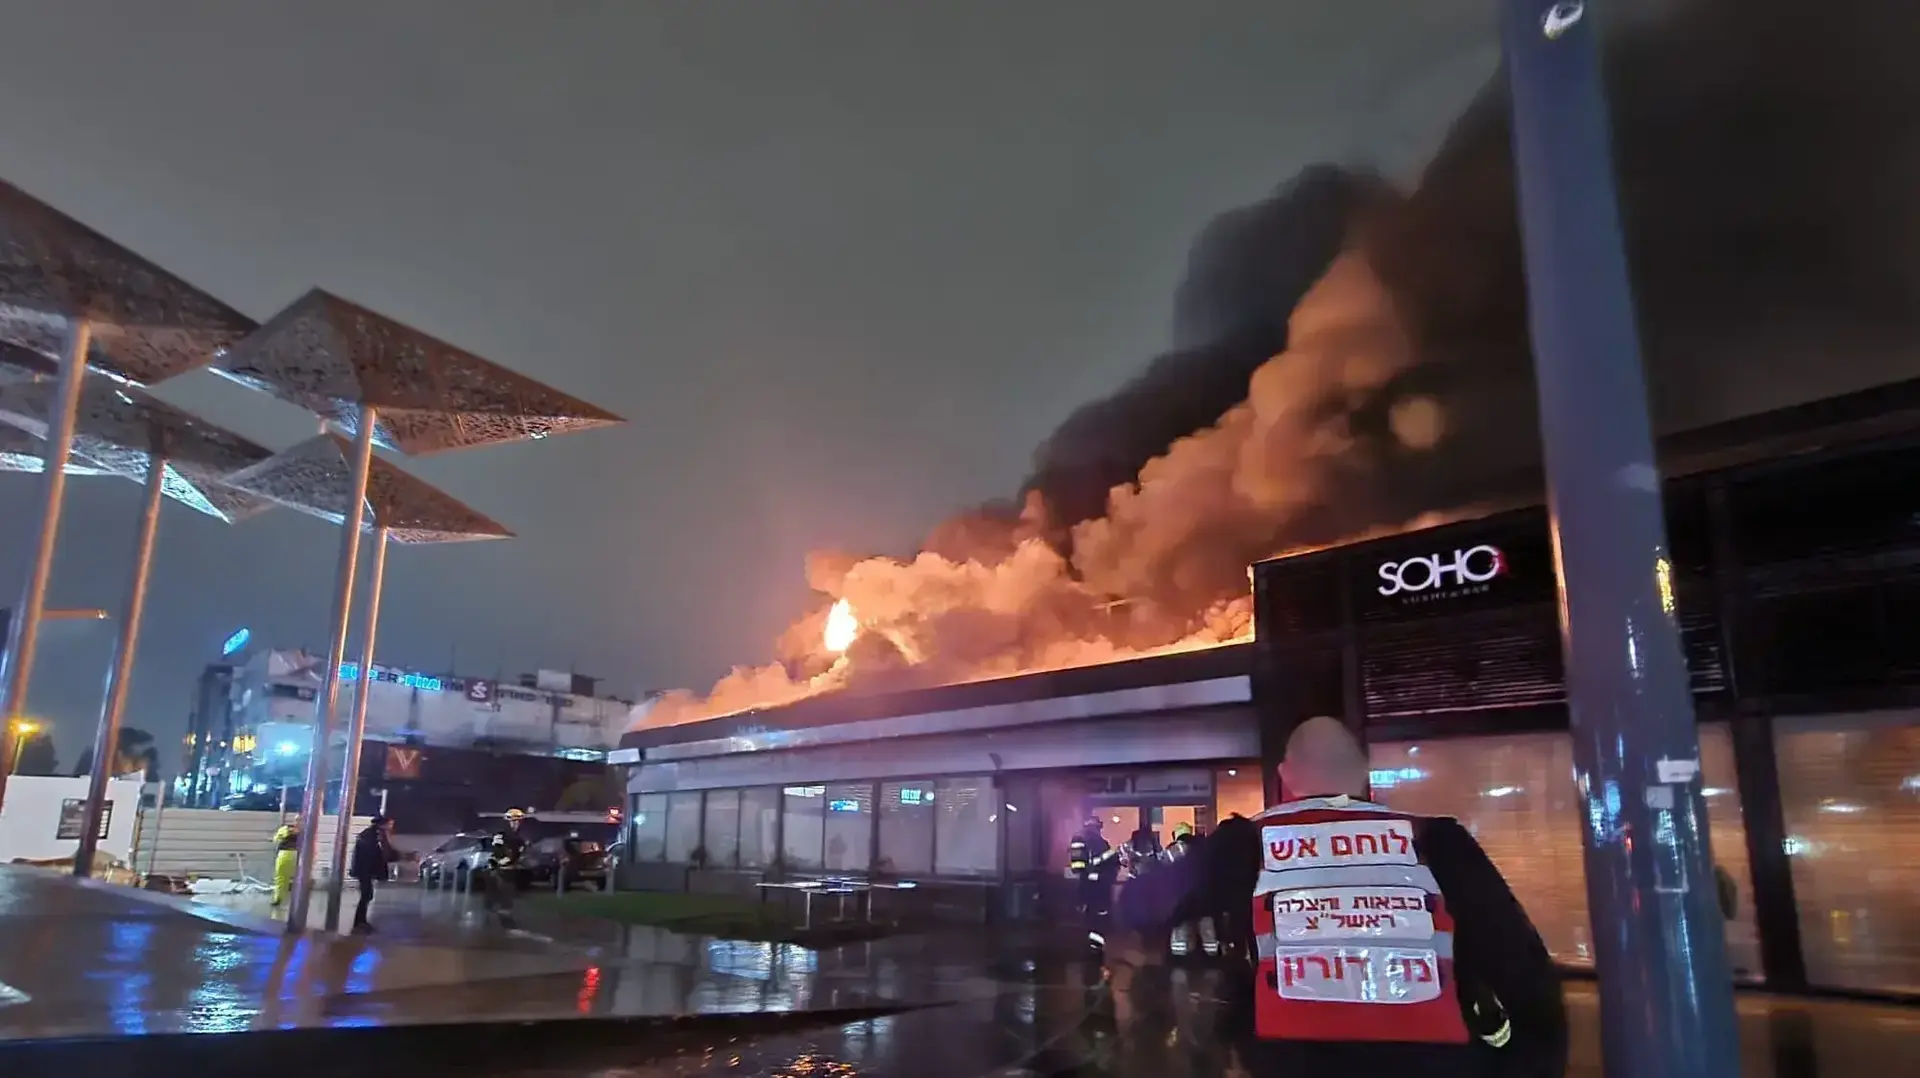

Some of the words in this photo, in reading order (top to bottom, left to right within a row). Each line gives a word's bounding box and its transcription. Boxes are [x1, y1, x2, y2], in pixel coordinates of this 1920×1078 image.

[1378, 545, 1500, 596] SOHO
[1270, 837, 1319, 861] אש
[1330, 828, 1409, 856] לוחם
[1278, 897, 1340, 914] והצלה
[1352, 895, 1423, 911] כבאות
[1283, 956, 1371, 987] דורון
